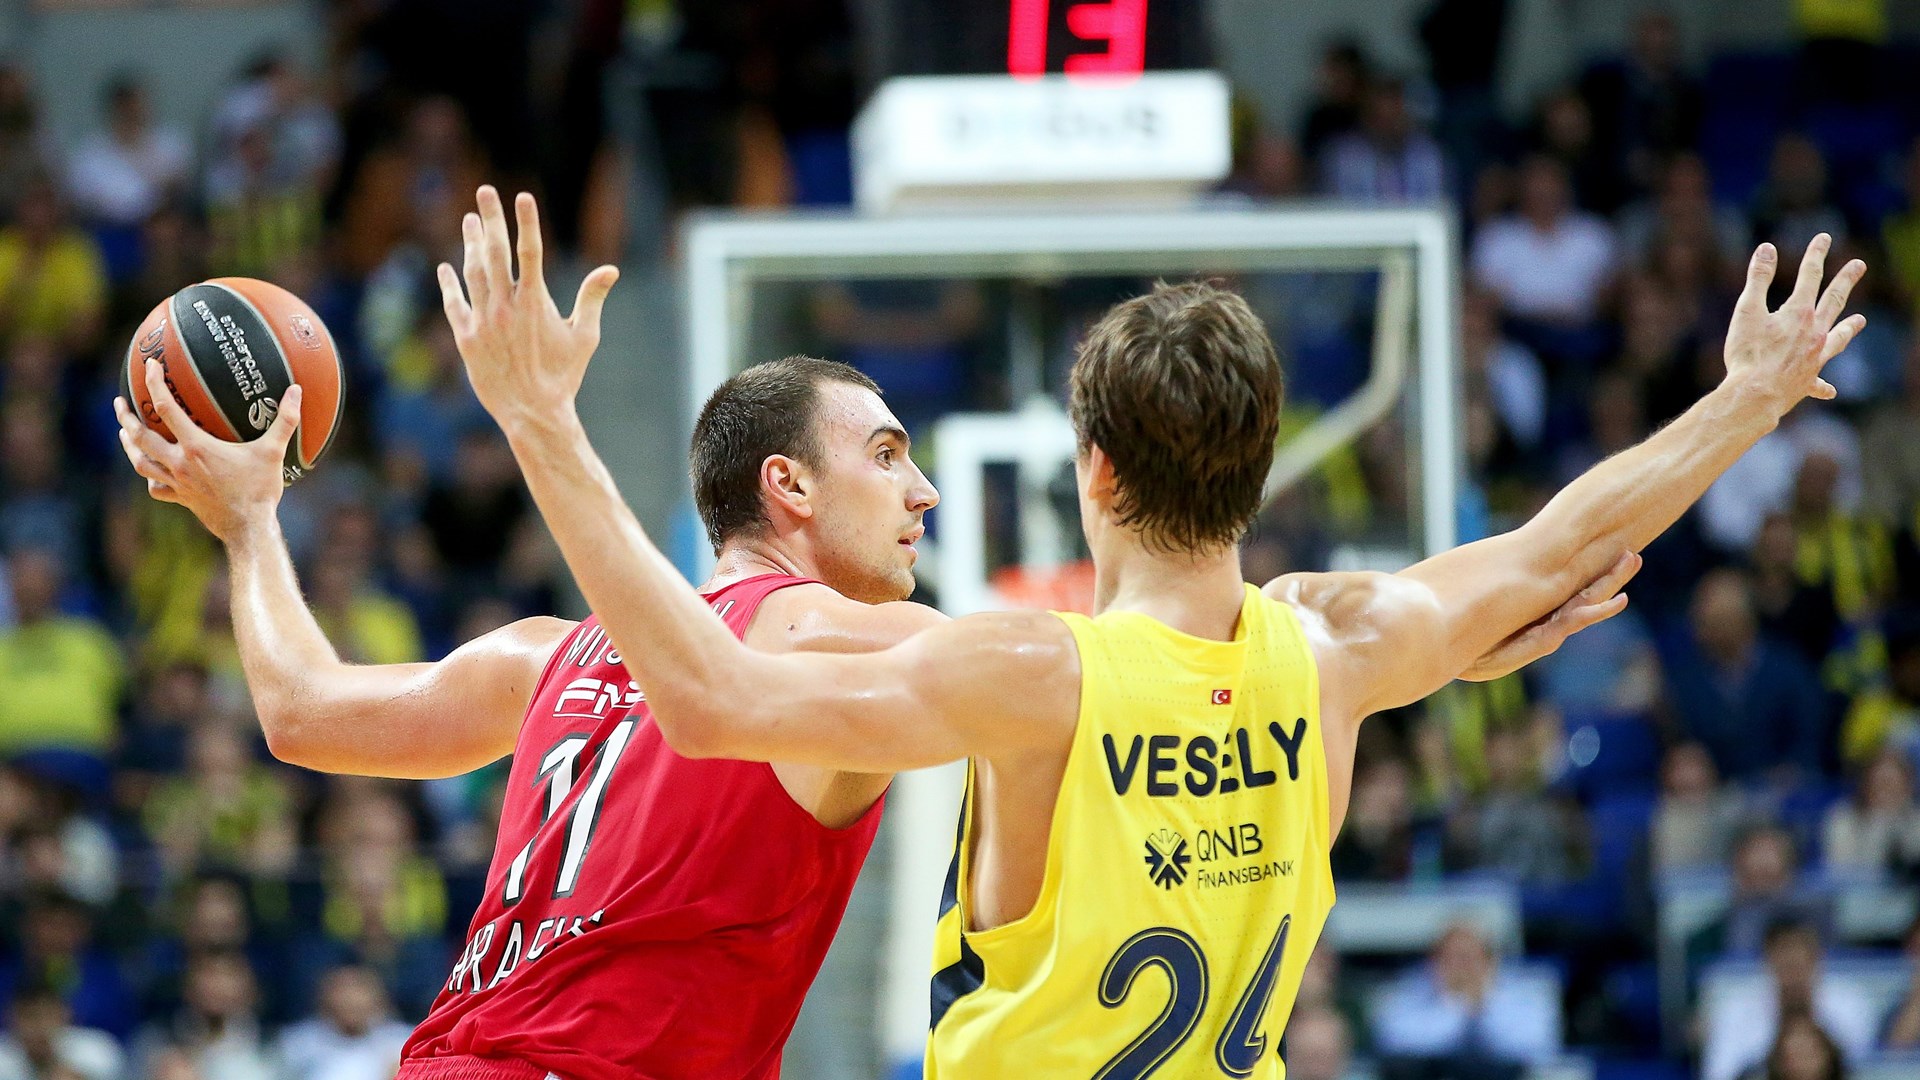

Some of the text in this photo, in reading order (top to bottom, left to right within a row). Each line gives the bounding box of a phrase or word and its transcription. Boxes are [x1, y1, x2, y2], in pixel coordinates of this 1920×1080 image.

[192, 300, 255, 401] TURKISH AIRLINES
[502, 715, 640, 907] 11
[1196, 823, 1263, 862] QNB
[1197, 860, 1294, 890] FINANSBANK
[1090, 914, 1291, 1080] 24
